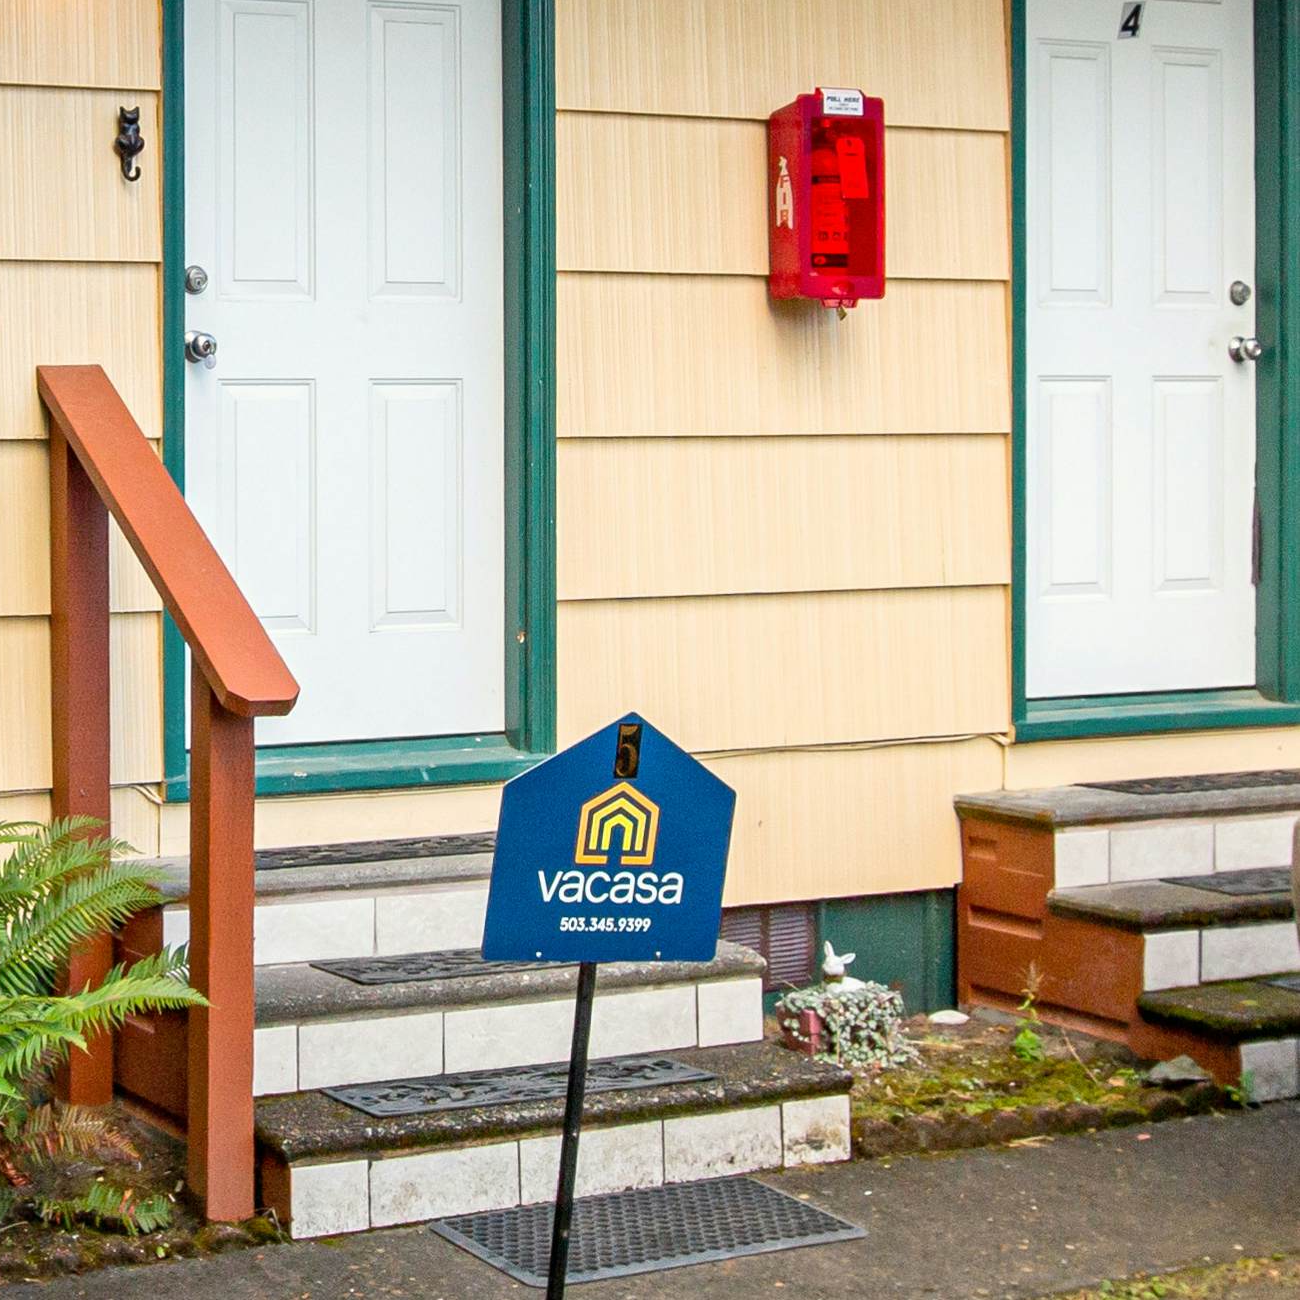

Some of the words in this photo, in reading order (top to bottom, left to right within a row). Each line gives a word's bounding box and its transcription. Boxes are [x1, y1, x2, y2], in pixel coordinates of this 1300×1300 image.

[1120, 3, 1142, 37] 4
[615, 724, 640, 777] 5
[538, 870, 684, 904] vacasa
[559, 917, 651, 932] 503.345.9399
